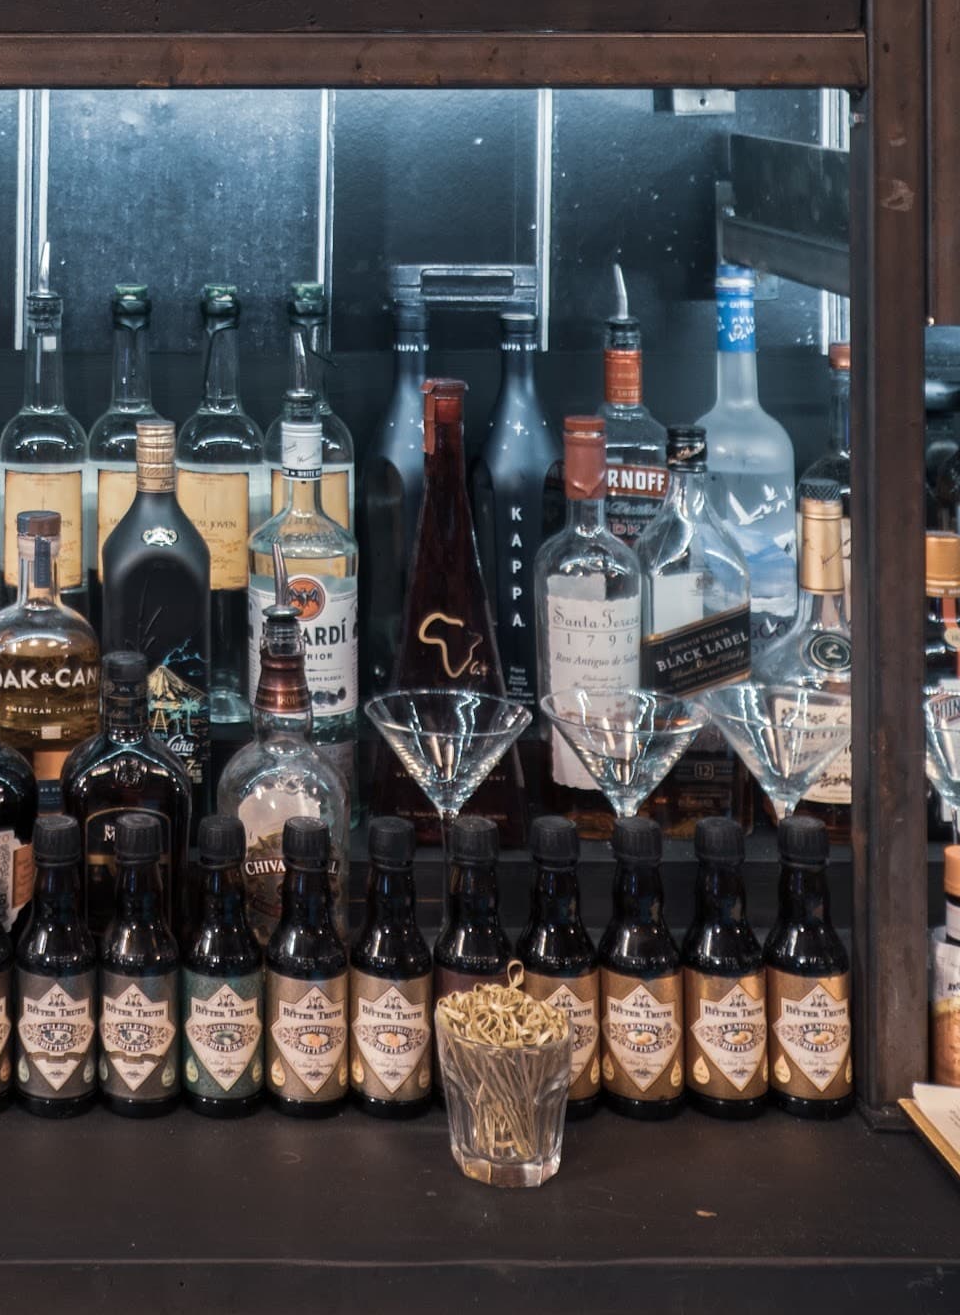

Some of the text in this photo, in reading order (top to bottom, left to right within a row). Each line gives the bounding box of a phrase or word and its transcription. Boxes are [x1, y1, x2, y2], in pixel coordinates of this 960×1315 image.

[608, 471, 665, 492] RNOFF
[210, 520, 237, 529] JOVEN
[510, 507, 524, 629] KAPPA
[553, 606, 598, 629] Santa
[656, 648, 702, 672] BLACK
[705, 631, 749, 654] LABEL
[574, 654, 610, 669] Antiguo
[5, 705, 52, 715] AMERICAN
[245, 861, 286, 876] CHIVA
[27, 1003, 87, 1017] BITTER TRUTH
[105, 1002, 165, 1017] BITTER TRUTH
[195, 1003, 254, 1018] BITTER TRUTH
[283, 1006, 342, 1021] BITTER TRUTH
[362, 1004, 423, 1020] BITTER TRUTH
[568, 1007, 592, 1018] TRUTH
[610, 1002, 672, 1018] BITTER TRUTH
[704, 1004, 763, 1018] BITTER TRUTH
[785, 1003, 846, 1018] BITTER TRUTH
[41, 1022, 74, 1032] CELERY
[118, 1022, 150, 1032] CELERY
[625, 1022, 659, 1034] LEMON
[721, 1023, 755, 1034] LEMON
[802, 1022, 835, 1033] LEMON
